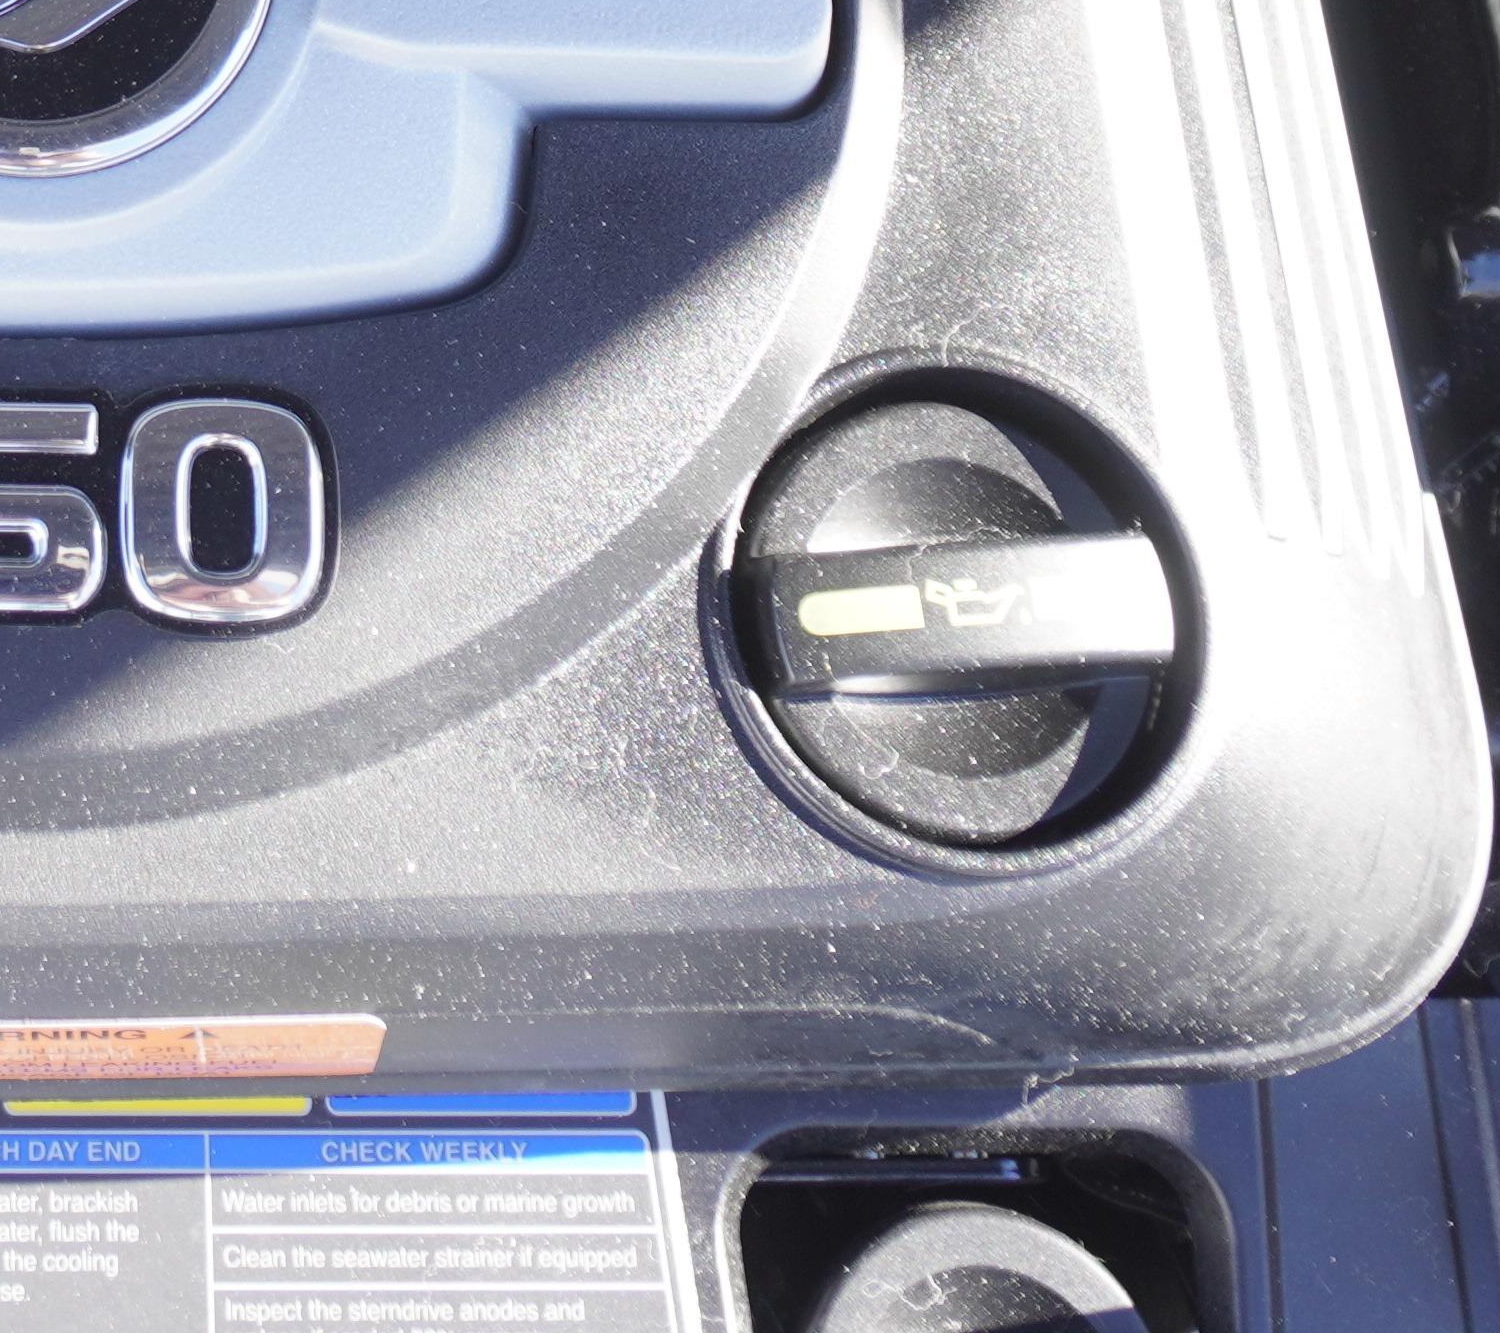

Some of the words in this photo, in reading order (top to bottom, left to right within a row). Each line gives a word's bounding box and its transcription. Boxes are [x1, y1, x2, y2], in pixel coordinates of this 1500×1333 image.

[28, 1140, 79, 1163] DAY
[88, 1140, 140, 1163] END
[322, 1142, 412, 1164] CHECK
[420, 1142, 527, 1164] WEEKLY
[49, 1191, 138, 1213] brackish
[222, 1191, 285, 1213] Water
[290, 1190, 348, 1213] inlets
[352, 1190, 381, 1213] for
[385, 1190, 451, 1213] debris
[456, 1194, 479, 1213] or
[484, 1190, 558, 1213] marine
[564, 1190, 635, 1218] growth
[48, 1220, 101, 1242] flush
[104, 1220, 139, 1242] the
[4, 1249, 37, 1272] the
[43, 1249, 119, 1277] cooling
[223, 1246, 286, 1269] Clean
[292, 1246, 324, 1269] the
[330, 1248, 428, 1269] seawater
[435, 1247, 514, 1269] strainer
[519, 1246, 533, 1269] if
[538, 1246, 637, 1274] equipped
[224, 1298, 303, 1325] Inspect
[308, 1298, 342, 1322] the
[349, 1298, 453, 1322] sterndrive
[460, 1298, 537, 1322] anodes
[543, 1298, 585, 1322] and
